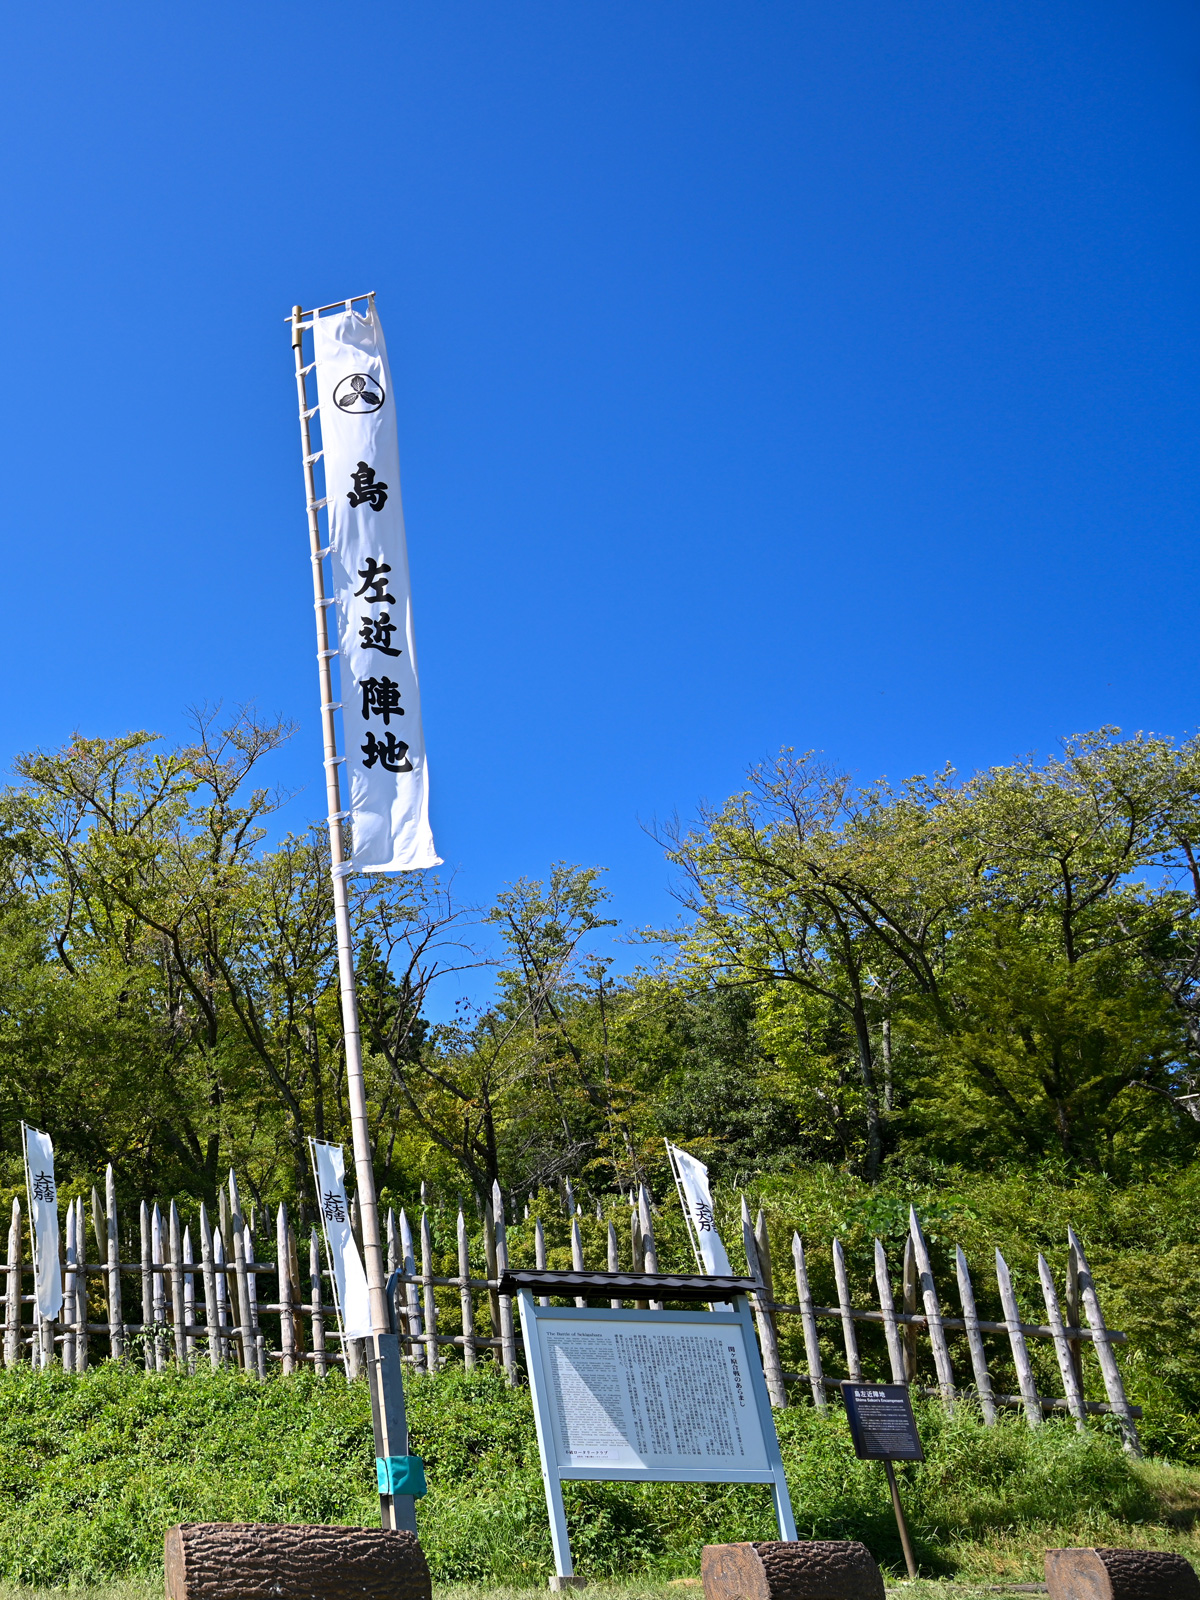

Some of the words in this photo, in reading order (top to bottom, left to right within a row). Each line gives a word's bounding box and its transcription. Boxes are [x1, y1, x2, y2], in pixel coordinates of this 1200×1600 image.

[854, 1390, 886, 1398] 島左近陣地
